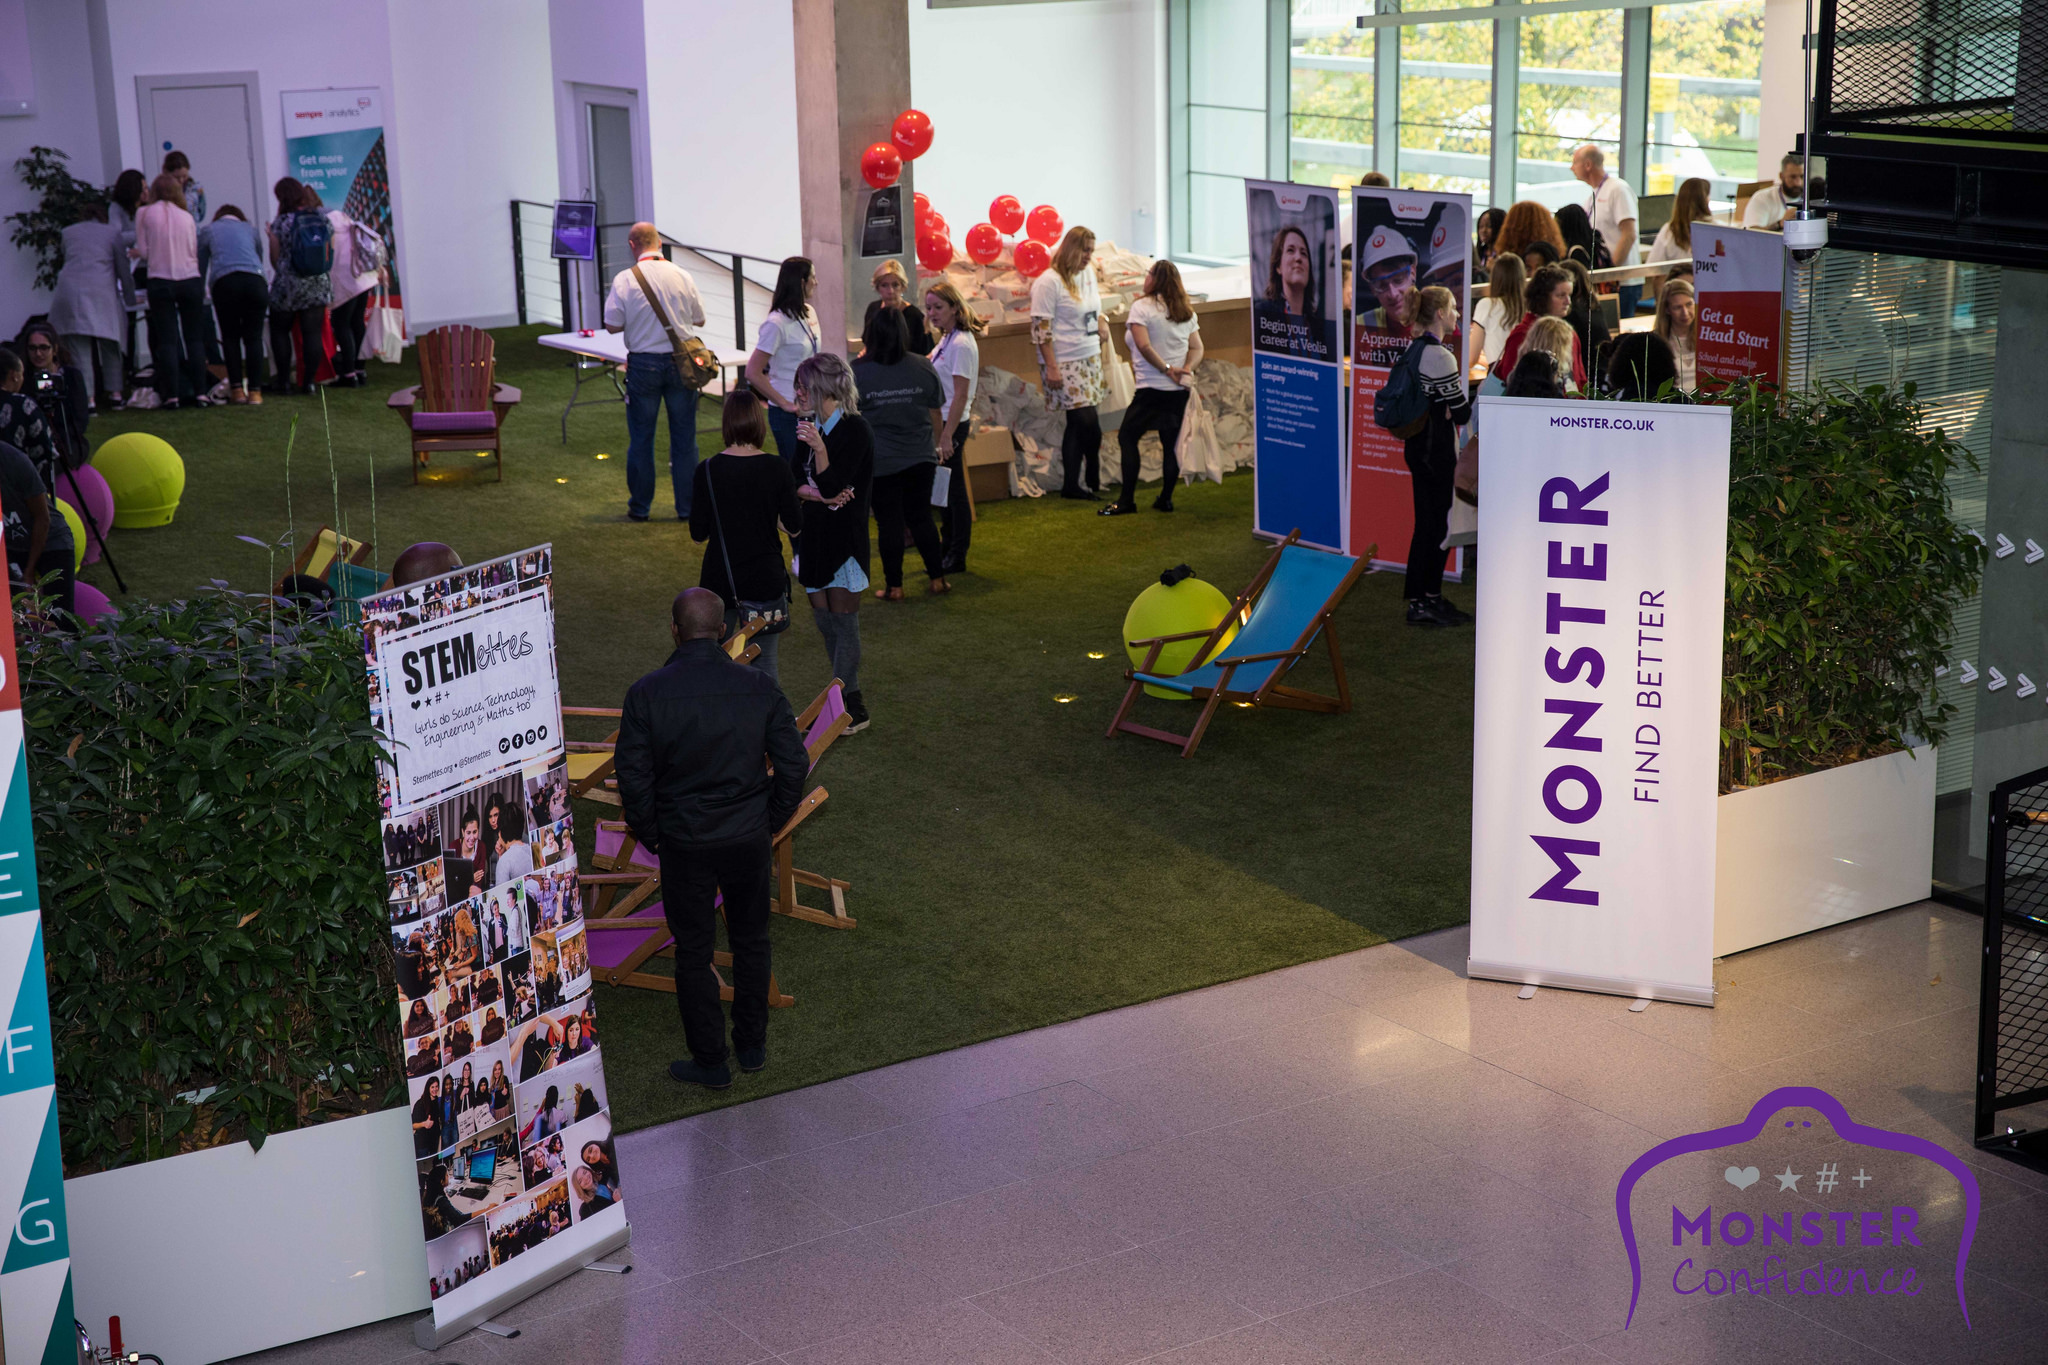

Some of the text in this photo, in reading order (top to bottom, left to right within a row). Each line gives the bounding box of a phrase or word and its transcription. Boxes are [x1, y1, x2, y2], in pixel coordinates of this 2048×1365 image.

[298, 154, 344, 165] Get more
[300, 167, 348, 179] from your
[1695, 260, 1718, 274] pwc
[1260, 316, 1309, 336] Begin your
[1701, 307, 1734, 326] Get a
[1260, 334, 1327, 354] career at Veolia
[1699, 325, 1769, 350] Head Start
[1360, 350, 1386, 363] with
[1698, 351, 1719, 363] School
[1719, 355, 1735, 365] and
[1261, 360, 1273, 370] Join
[1280, 365, 1319, 381] award-winning
[1261, 372, 1286, 385] company
[1360, 376, 1372, 385] Join
[1550, 415, 1655, 432] MONSTER.CO.UK
[402, 630, 534, 696] STEMettes
[1528, 470, 1610, 907] MONSTER
[1633, 589, 1665, 804] FIND BETTER
[414, 685, 536, 735] Girls do Science, Technology,
[423, 701, 531, 748] Engineering & Maths too
[412, 749, 492, 786] Stemettes.org @Stemettes
[5, 1025, 34, 1075] F
[14, 1198, 56, 1246] G
